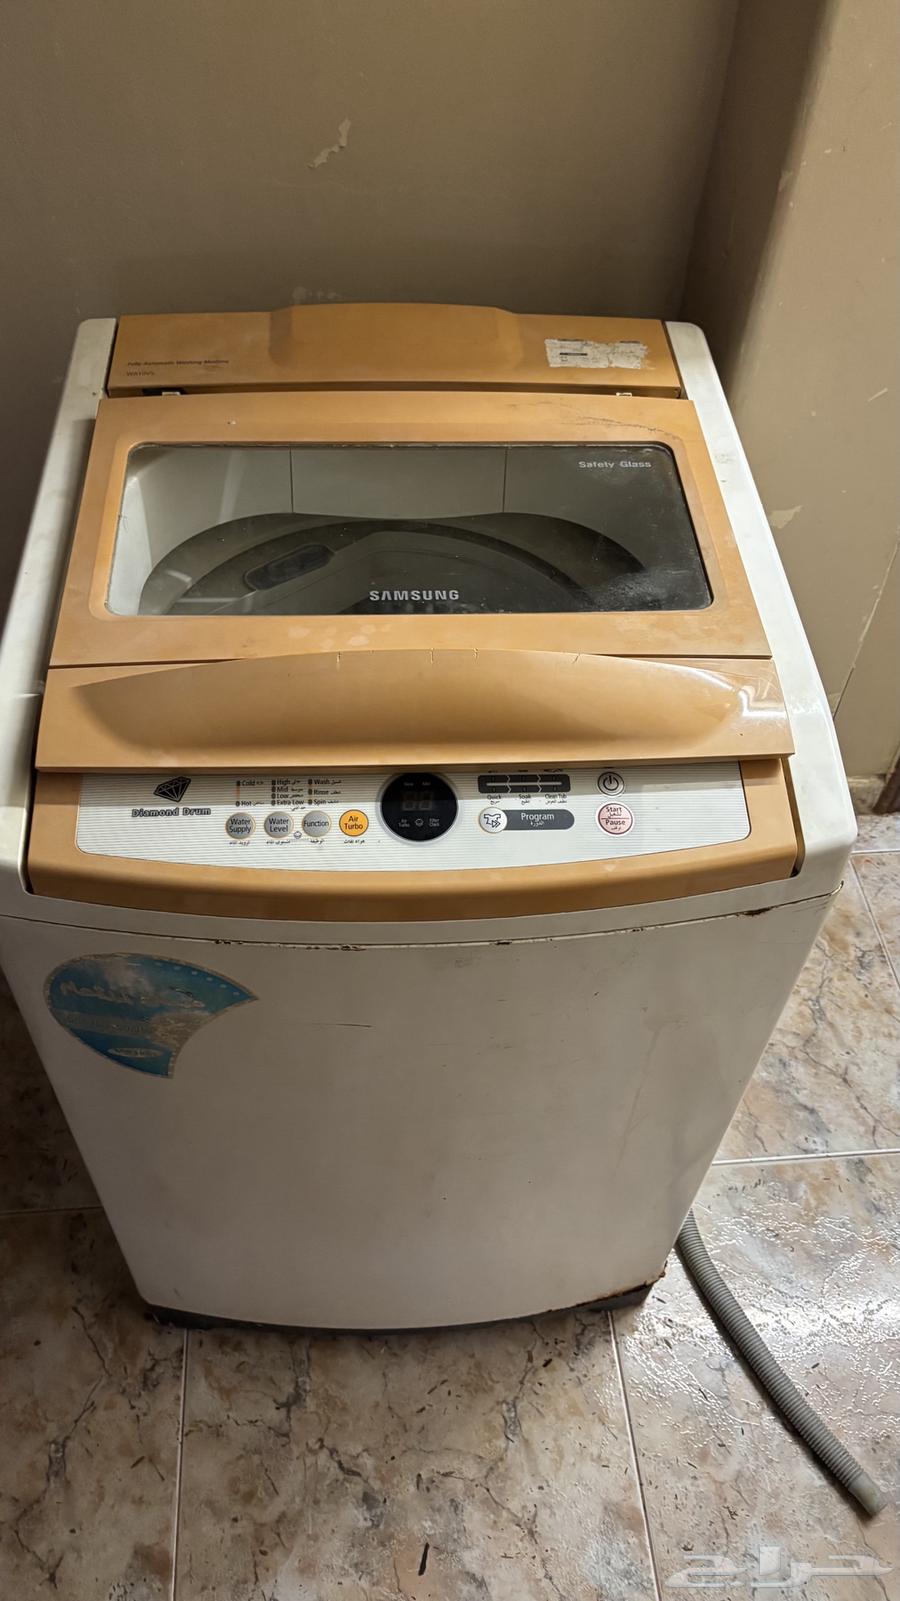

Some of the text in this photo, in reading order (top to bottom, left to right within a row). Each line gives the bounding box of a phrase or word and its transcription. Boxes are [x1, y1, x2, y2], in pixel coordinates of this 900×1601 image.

[620, 460, 652, 468] Glass
[369, 590, 459, 601] SAMSUNG
[276, 778, 291, 786] High
[313, 798, 327, 806] Spin
[131, 806, 212, 818] Diamond Drum
[269, 817, 289, 825] Water
[348, 815, 359, 823] Air
[520, 812, 555, 822] Program
[303, 819, 330, 827] Function
[343, 822, 364, 830] Turbo
[229, 825, 252, 834] Supply
